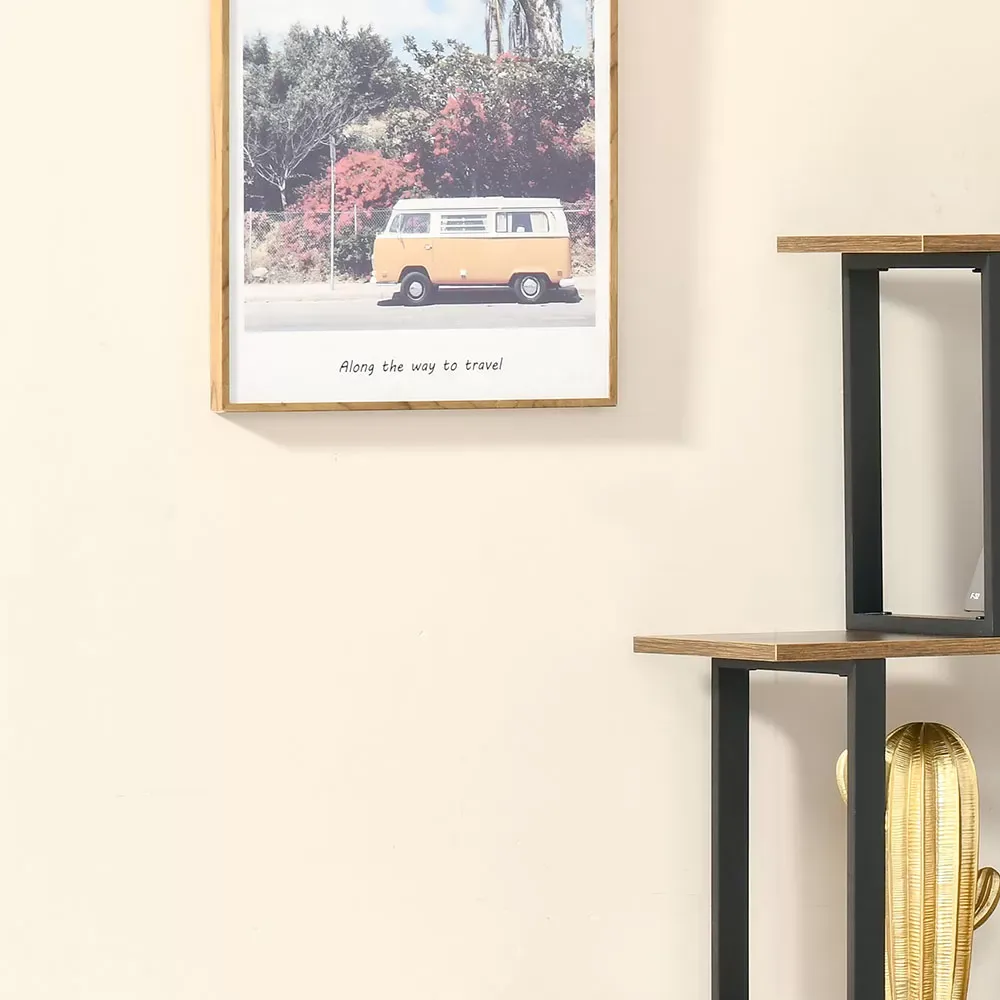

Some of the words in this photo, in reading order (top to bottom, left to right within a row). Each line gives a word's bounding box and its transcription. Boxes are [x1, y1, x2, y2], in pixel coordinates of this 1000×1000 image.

[339, 359, 375, 376] Along
[382, 359, 404, 372] the
[411, 362, 436, 375] way
[443, 359, 458, 371] to
[465, 357, 504, 371] travel
